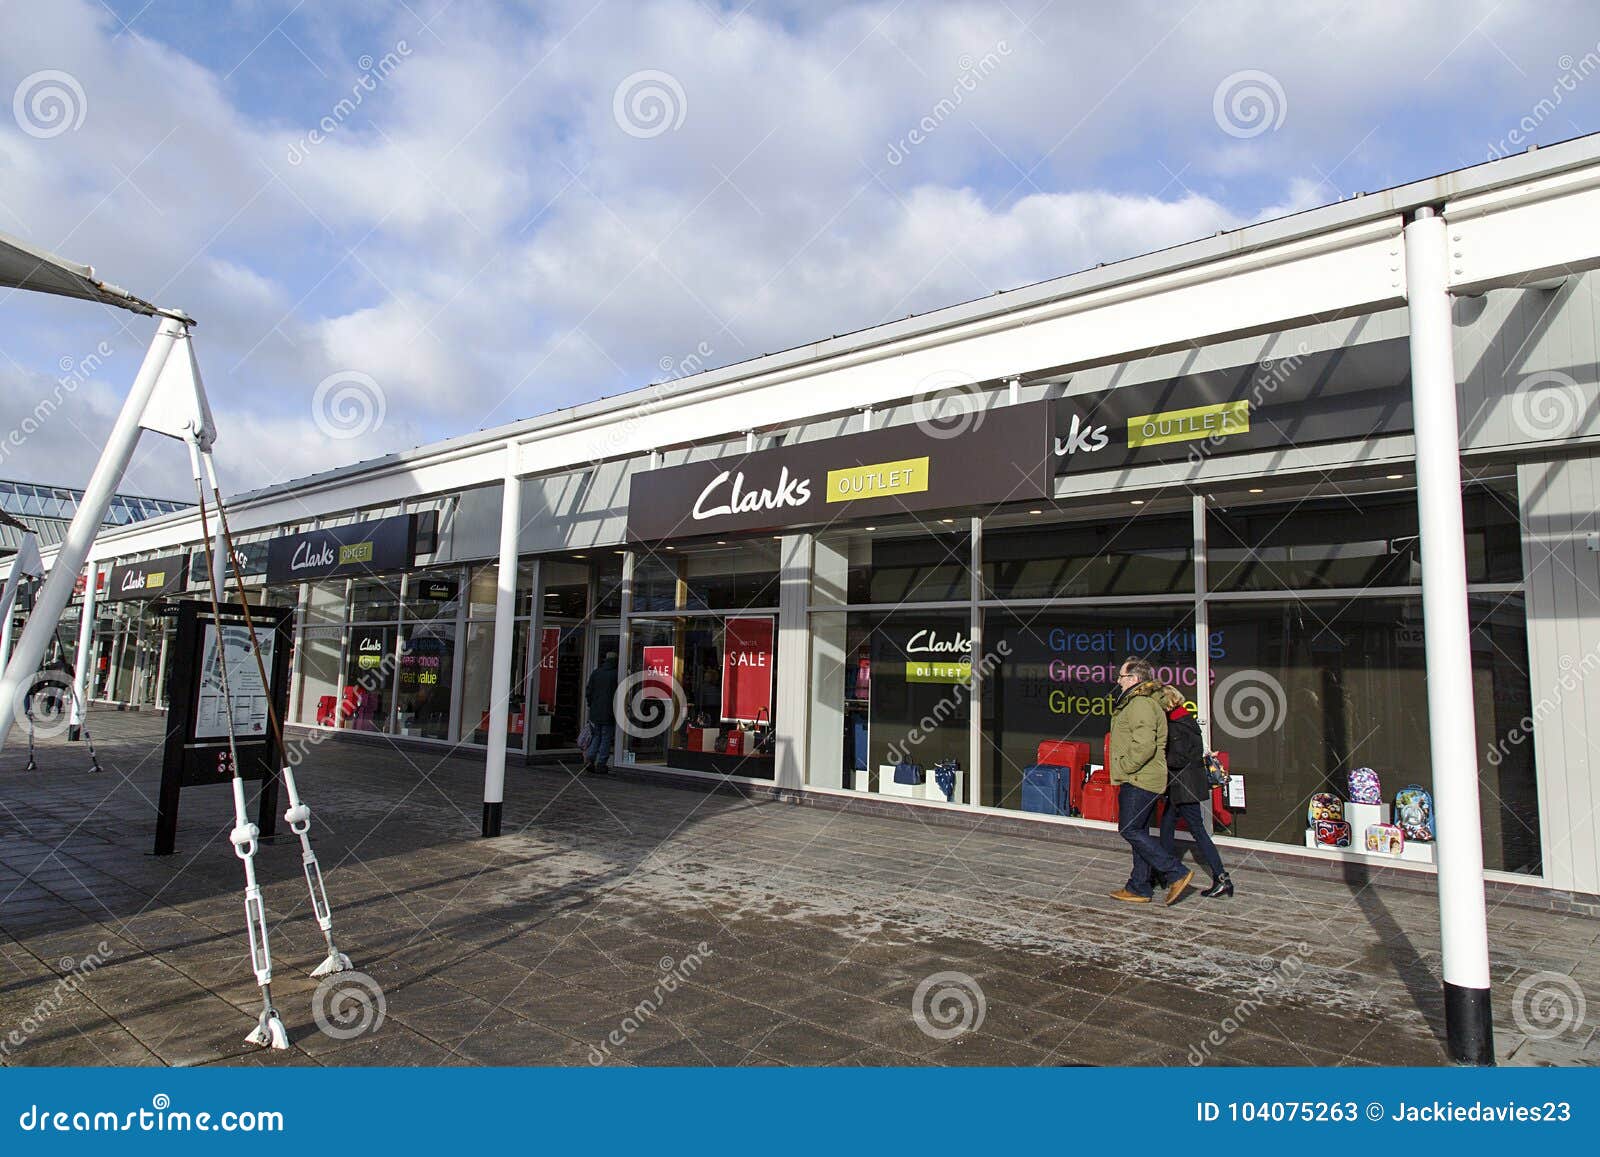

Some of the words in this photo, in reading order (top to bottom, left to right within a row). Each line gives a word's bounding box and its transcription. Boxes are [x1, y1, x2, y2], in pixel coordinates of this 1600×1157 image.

[1142, 411, 1234, 438] OUTLET
[692, 465, 812, 520] Clarks
[838, 469, 913, 495] OUTLET
[291, 541, 334, 570] Clarks
[342, 546, 368, 560] OUTLET
[121, 569, 145, 591] Clarks
[360, 637, 382, 651] Clarks
[906, 629, 972, 653] Clarks
[1049, 628, 1115, 652] Great
[647, 665, 669, 677] SALE
[730, 651, 765, 667] SALE
[916, 667, 962, 678] OUTLET
[1049, 659, 1115, 684] Great
[1049, 690, 1115, 715] Great
